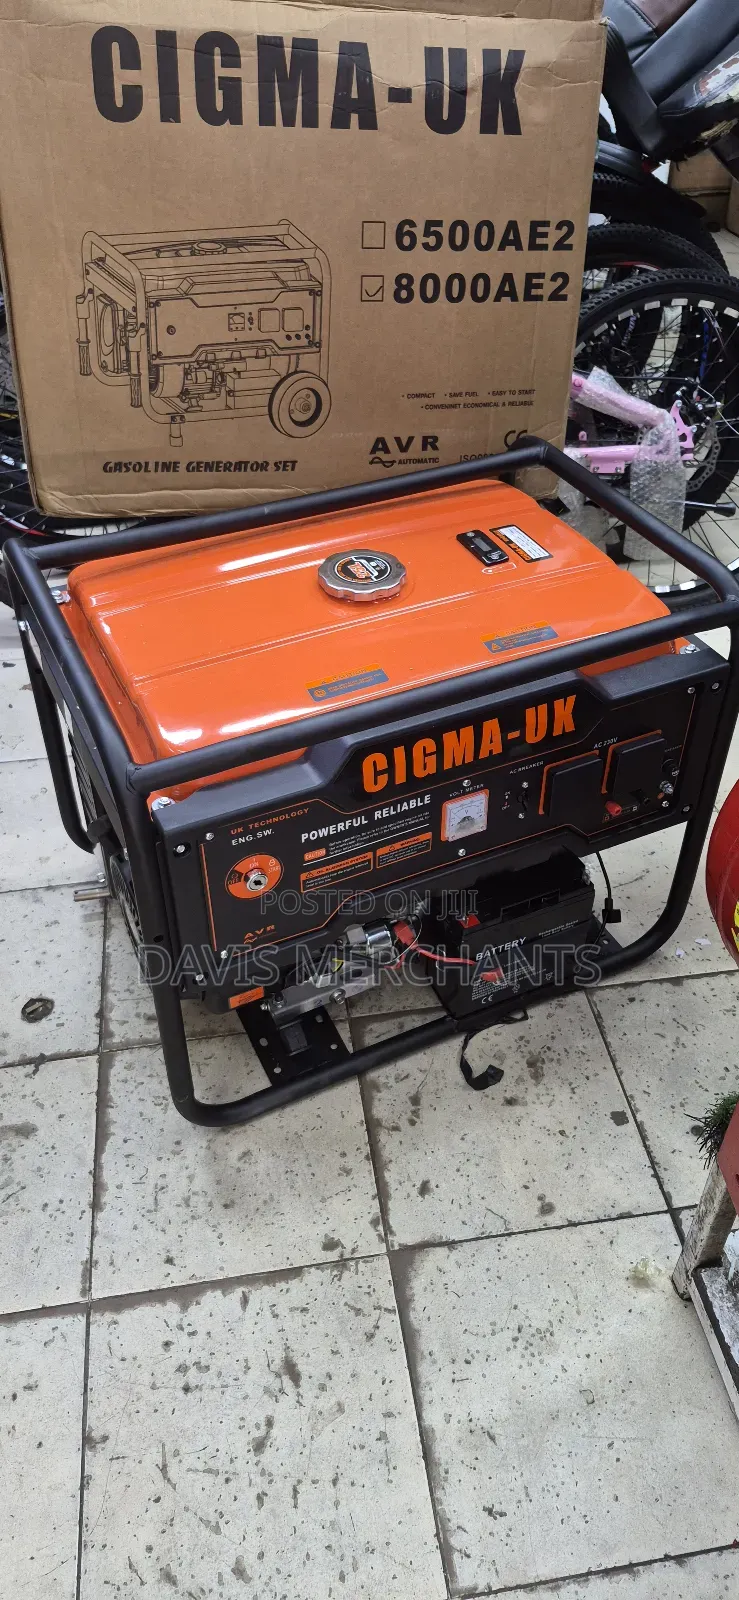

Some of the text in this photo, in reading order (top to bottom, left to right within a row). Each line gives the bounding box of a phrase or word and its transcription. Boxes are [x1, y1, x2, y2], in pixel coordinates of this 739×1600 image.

[90, 25, 526, 136] CIGMA-UK
[394, 219, 575, 252] 6500AE2
[393, 271, 570, 304] 8000AE2
[185, 460, 270, 473] GENERATOR
[273, 459, 299, 472] SET
[397, 457, 440, 465] AUTOMATIC
[361, 694, 577, 793] CIGMA-UK
[593, 741, 603, 749] AC
[230, 827, 244, 836] UK
[247, 807, 310, 830] TECHNOLOGY
[300, 815, 369, 844] POWERFUL
[374, 793, 432, 821] RELIABLE
[304, 849, 326, 860] CAUTION
[475, 936, 527, 961] BATTERY
